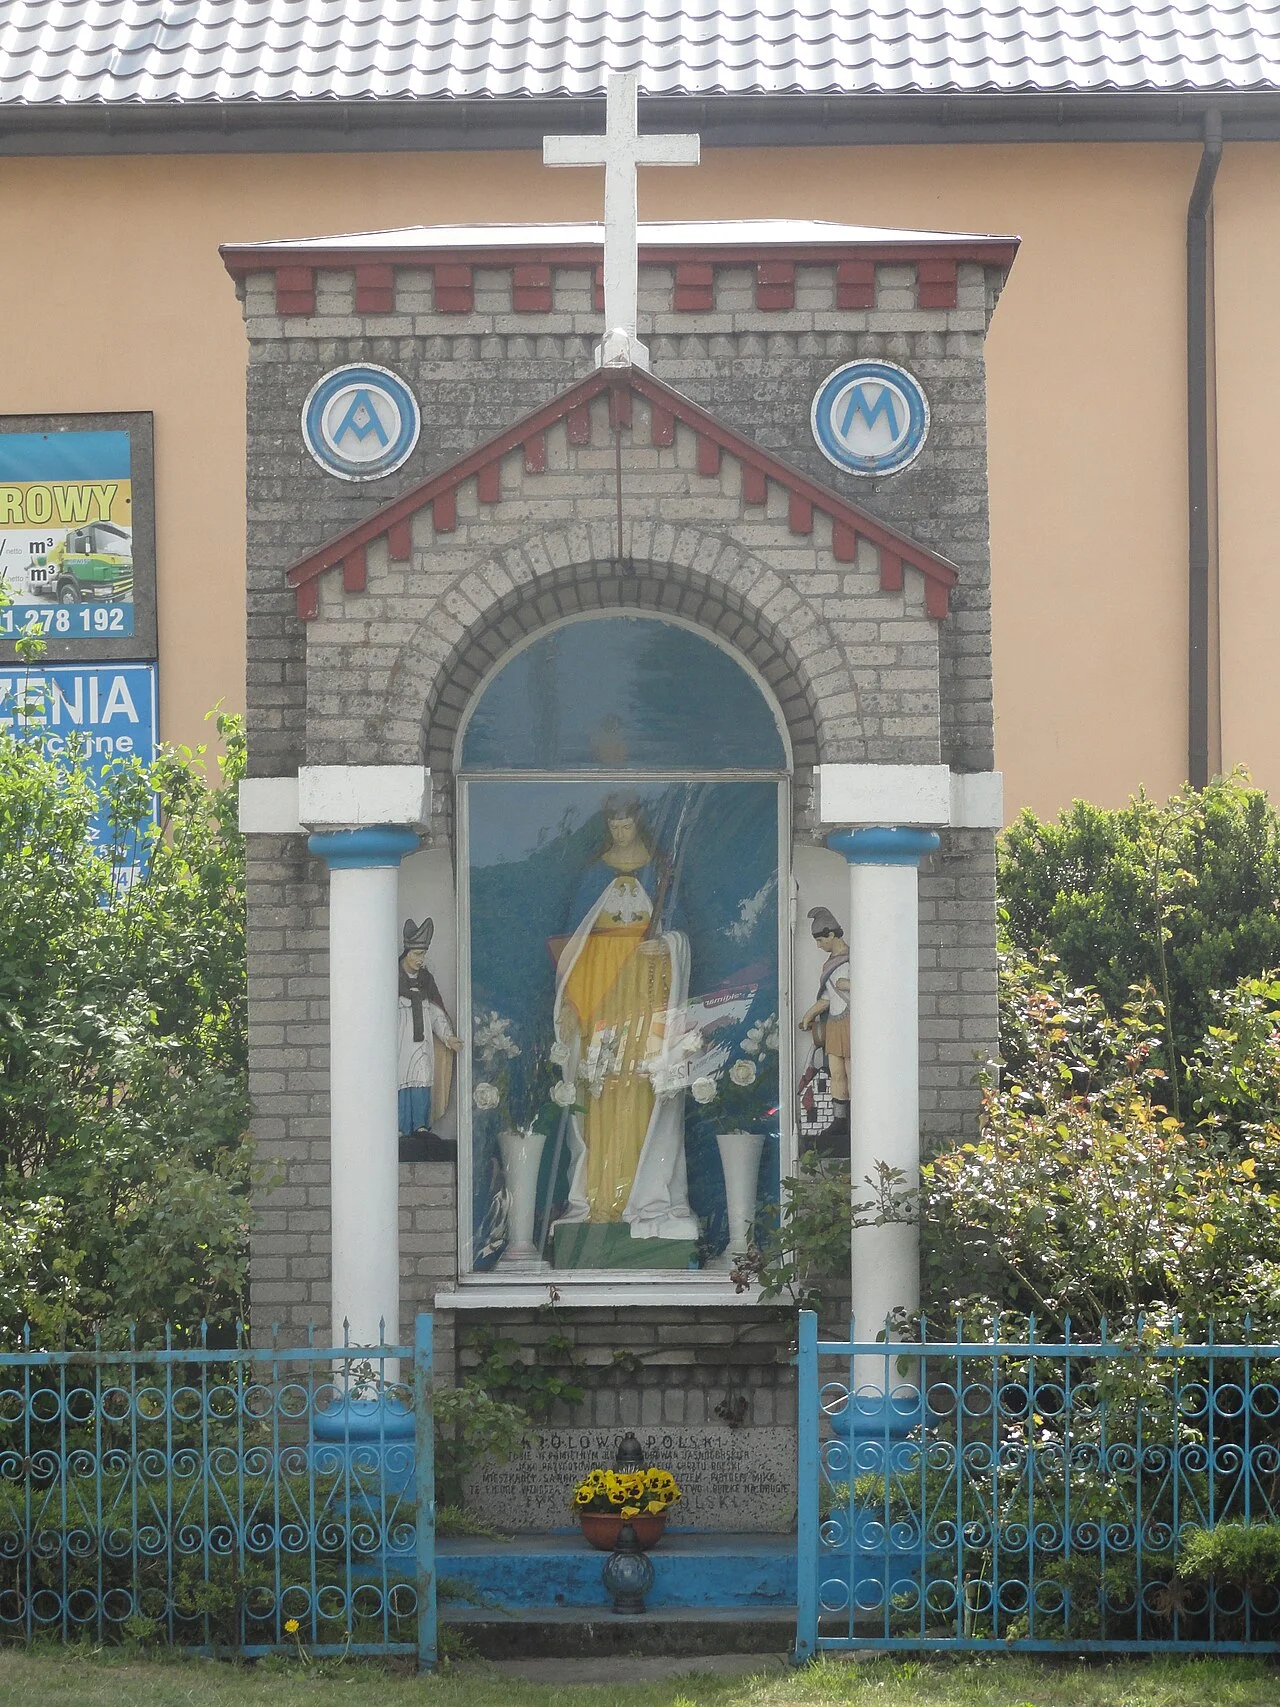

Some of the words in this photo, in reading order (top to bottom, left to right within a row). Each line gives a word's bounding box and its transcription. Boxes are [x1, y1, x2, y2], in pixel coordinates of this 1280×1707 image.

[841, 384, 899, 441] M
[0, 484, 118, 524] ROWY
[25, 609, 70, 632] 278
[80, 608, 124, 631] 192
